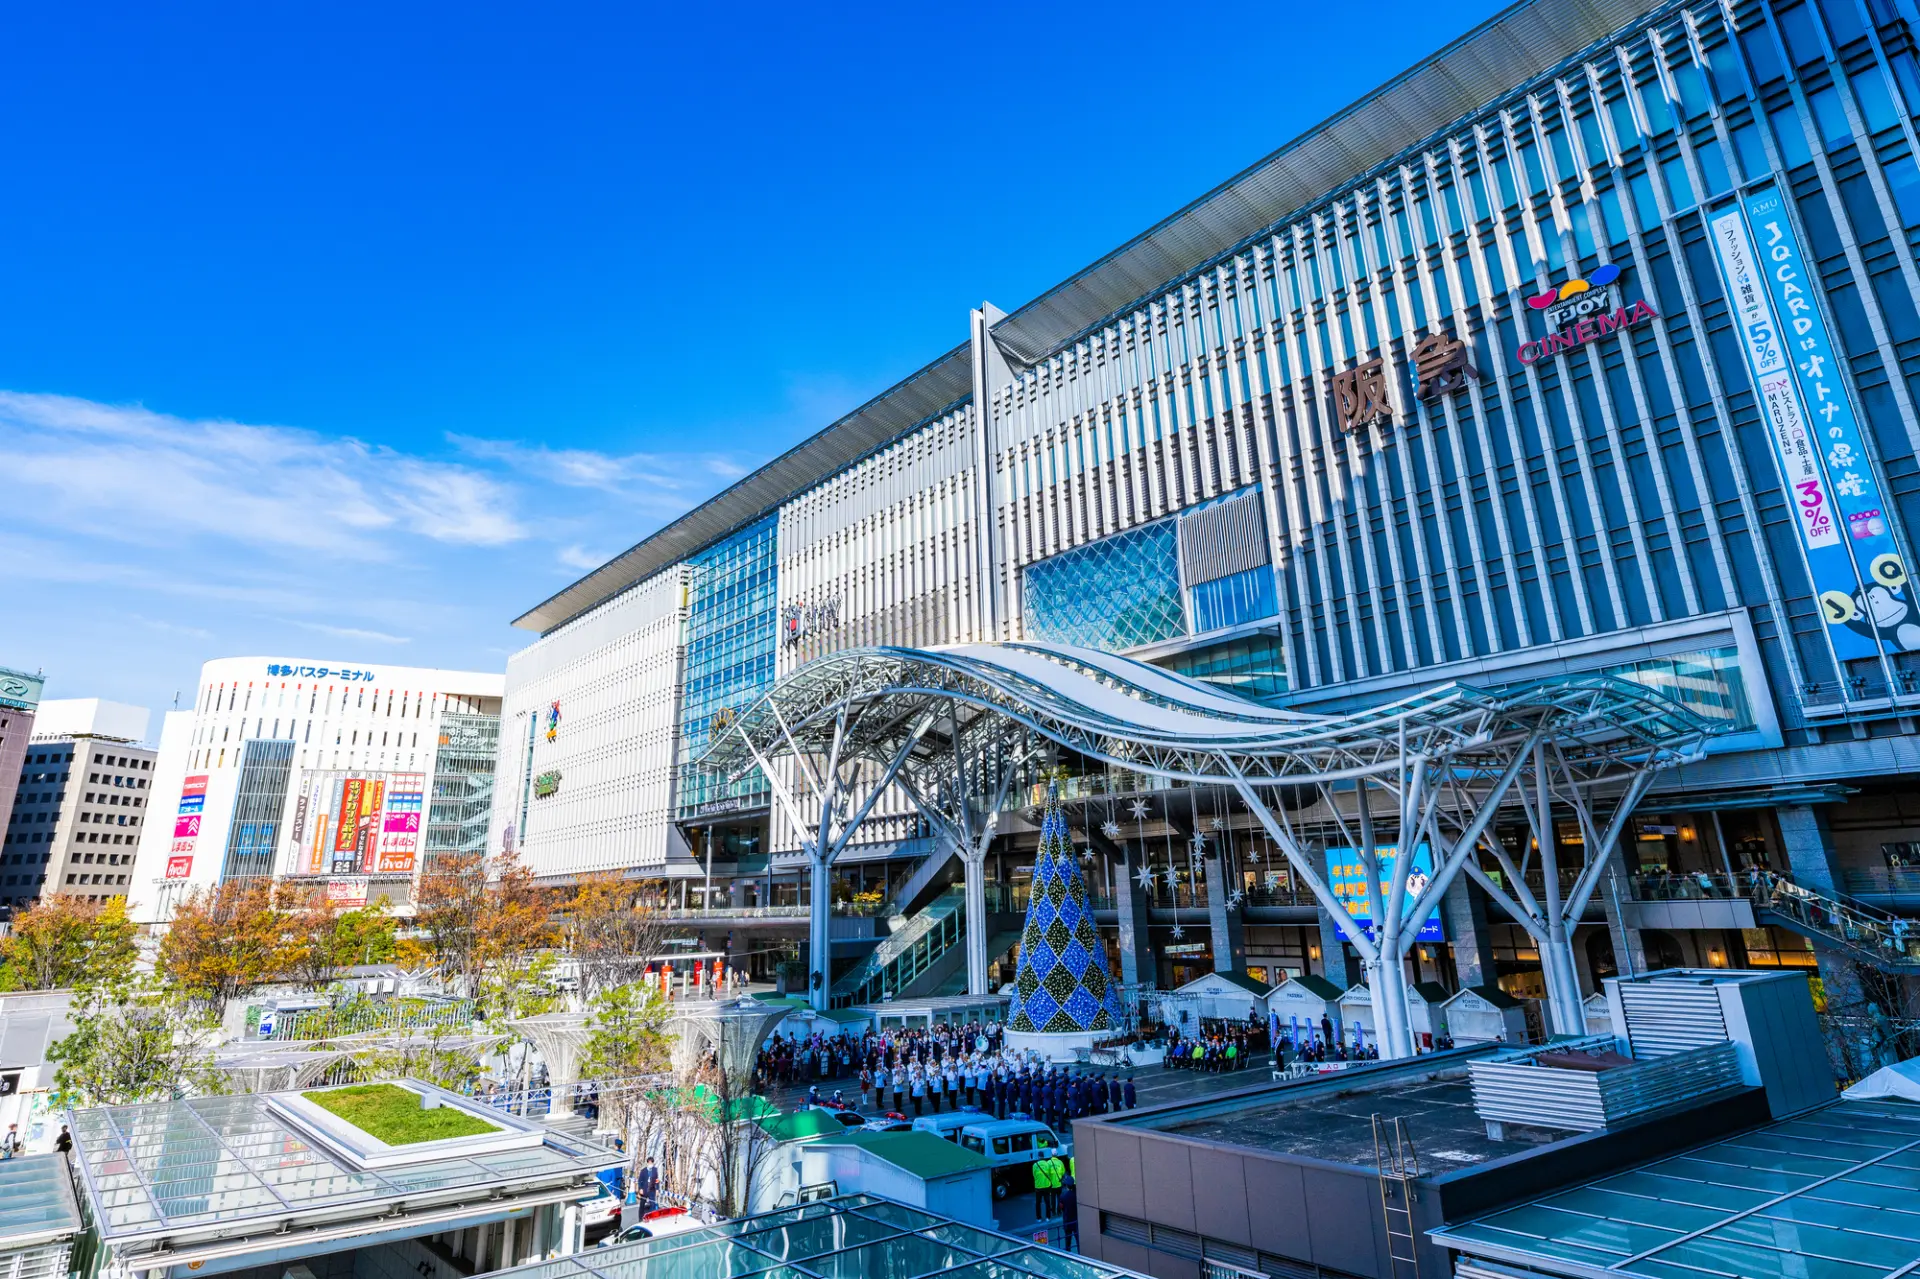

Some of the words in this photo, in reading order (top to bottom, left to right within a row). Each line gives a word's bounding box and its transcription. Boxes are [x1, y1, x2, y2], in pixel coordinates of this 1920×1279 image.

[1752, 198, 1778, 216] AMU
[1724, 230, 1745, 275] ファッション
[1516, 299, 1658, 365] CINEMA
[1760, 356, 1778, 369] OFF
[1332, 333, 1480, 434] 阪急
[1781, 390, 1798, 427] レストラン
[1809, 524, 1832, 538] OFF
[267, 663, 375, 682] 博多バスターミナル
[382, 836, 415, 847] しまむら
[167, 862, 189, 876] Avail
[379, 857, 412, 870] Avail
